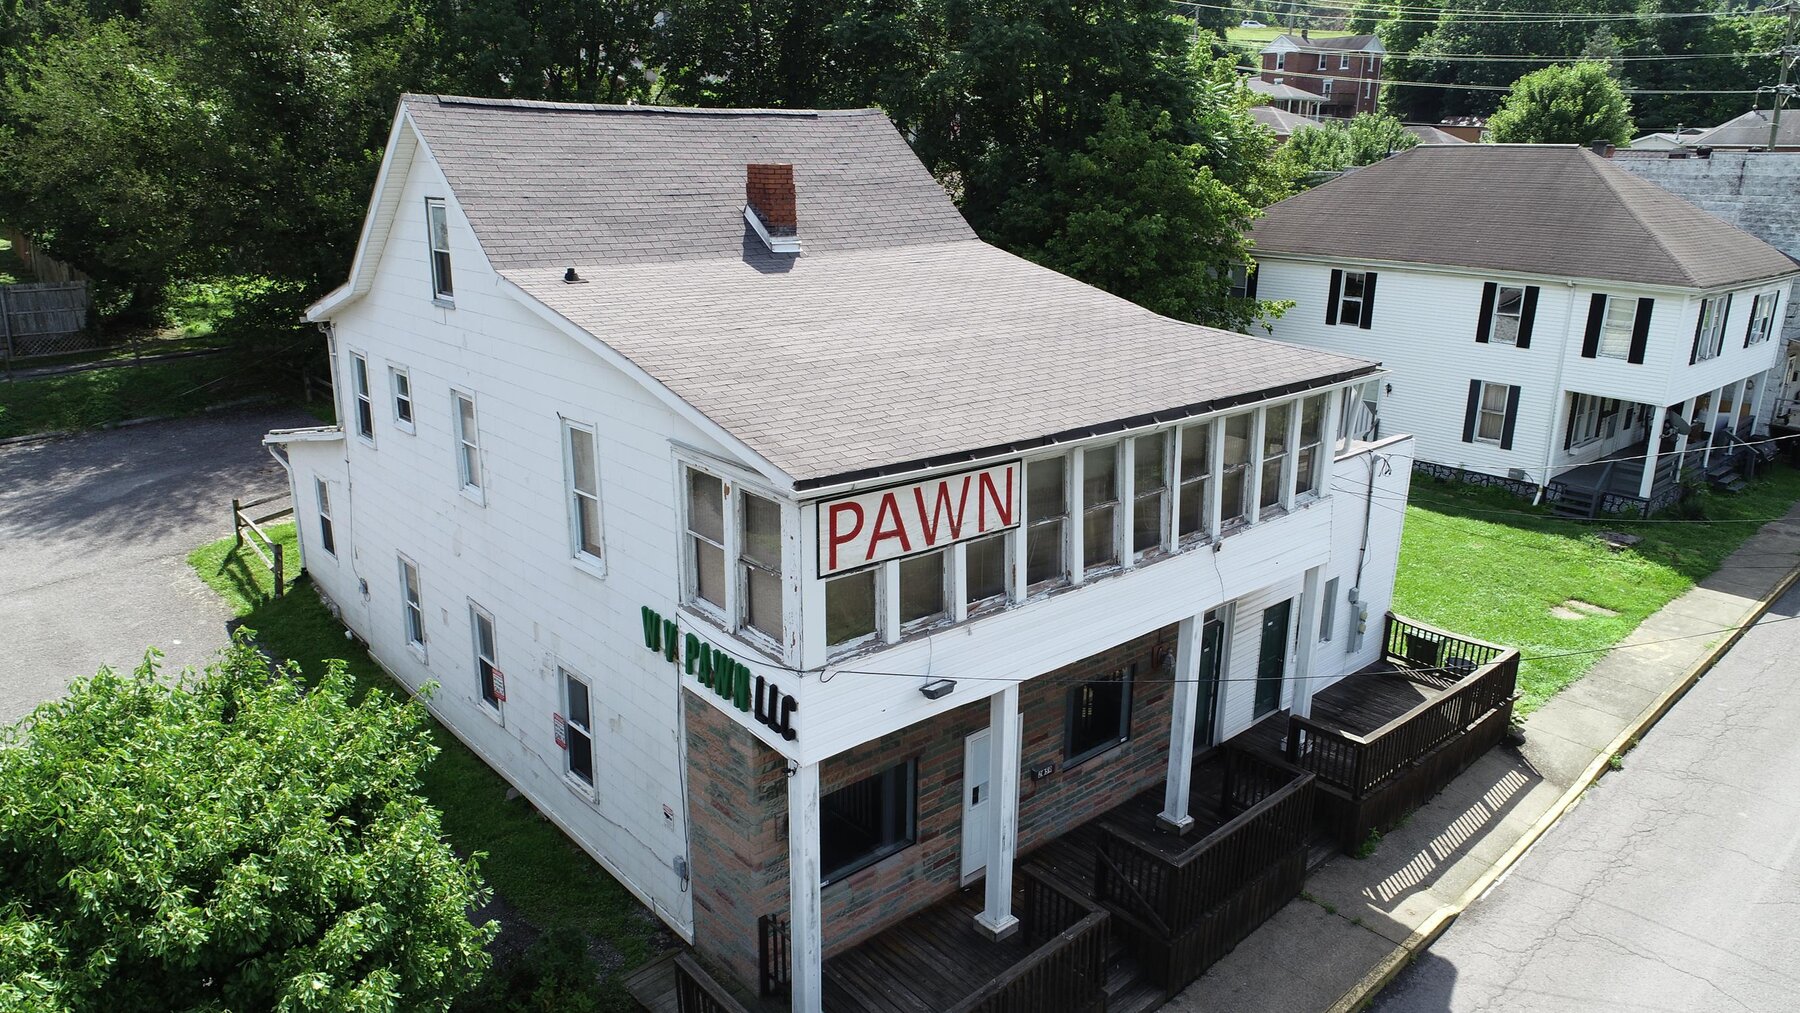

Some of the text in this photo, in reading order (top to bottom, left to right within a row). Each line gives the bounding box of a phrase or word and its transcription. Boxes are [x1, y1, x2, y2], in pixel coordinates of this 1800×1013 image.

[828, 466, 1013, 571] PAWN
[685, 632, 751, 712] PAWN
[754, 675, 797, 741] LLC
